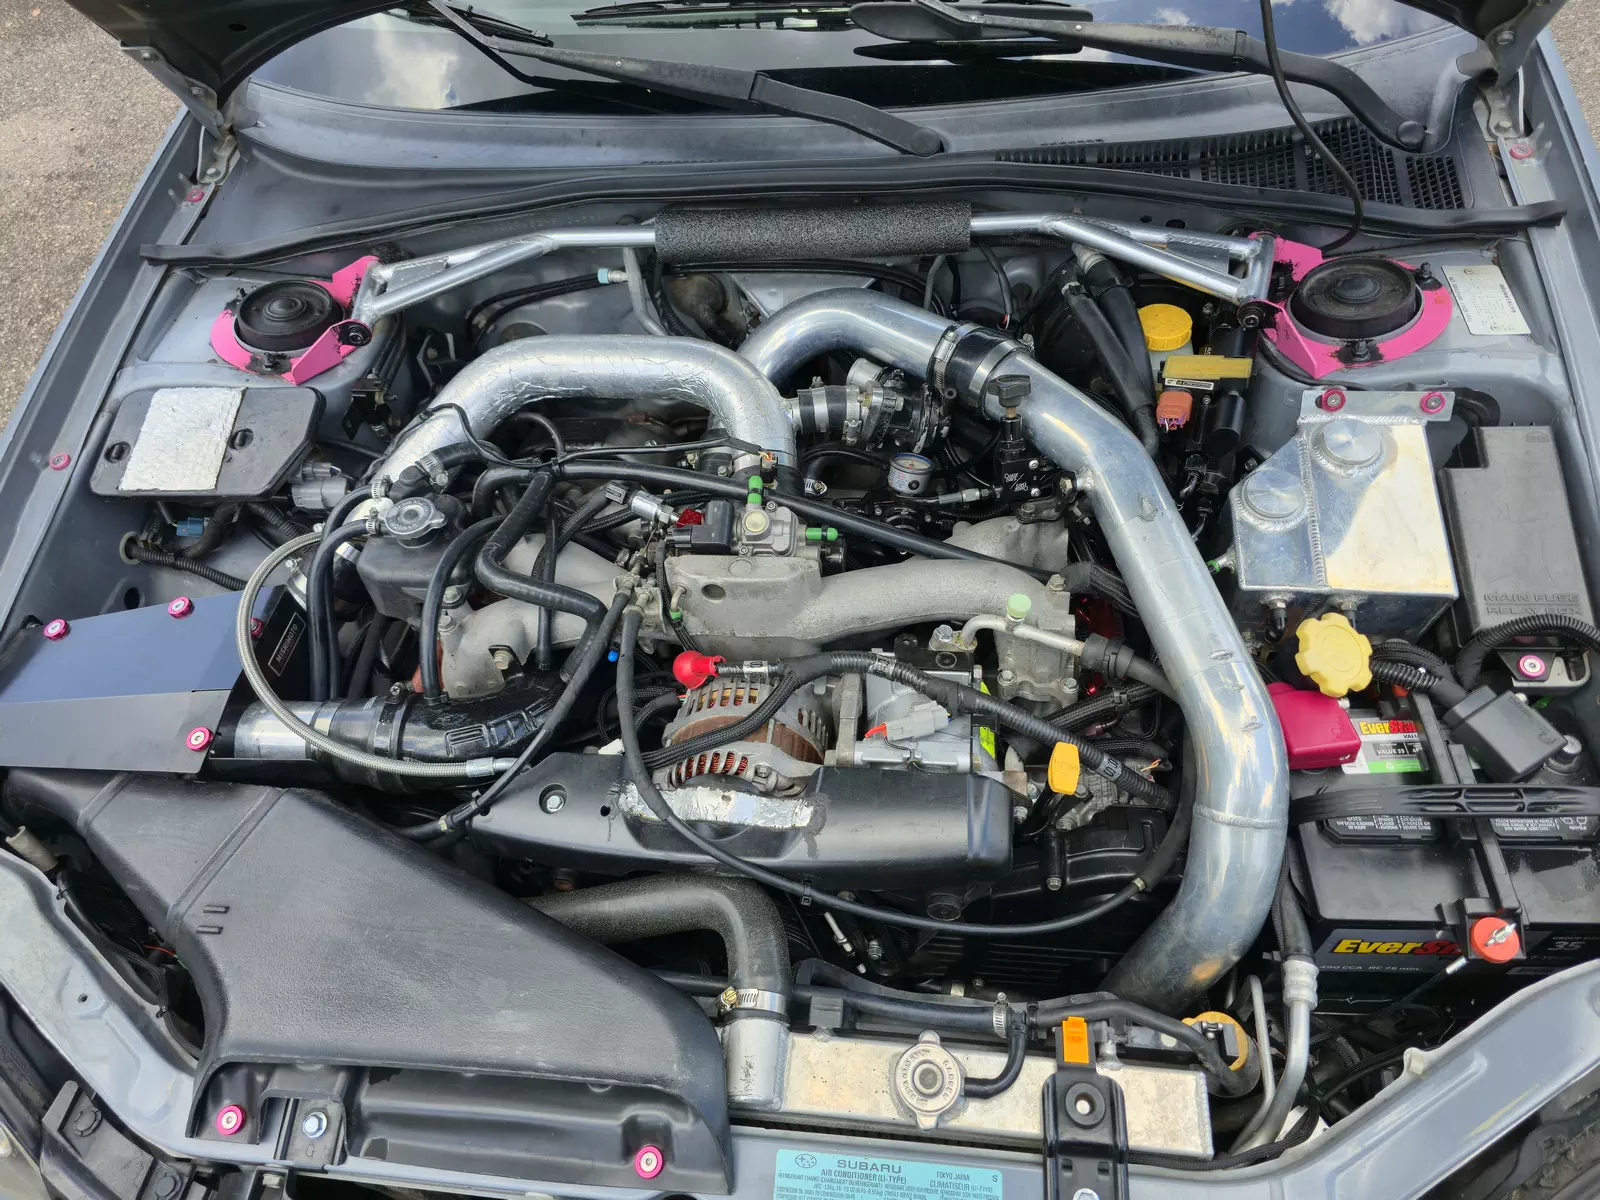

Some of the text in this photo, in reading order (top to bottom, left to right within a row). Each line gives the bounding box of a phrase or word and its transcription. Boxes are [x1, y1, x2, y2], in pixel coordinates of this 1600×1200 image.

[1484, 594, 1579, 602] MAIN FUSE
[1486, 606, 1582, 615] RELAY BOX
[275, 624, 298, 663] MISHIMOTO
[1548, 941, 1586, 950] 35
[837, 1160, 902, 1174] SUBARU
[833, 1170, 877, 1181] CONDITIONER
[936, 1171, 971, 1181] TOKYO JAPAN
[929, 1180, 970, 1191] CLIMATISEUR
